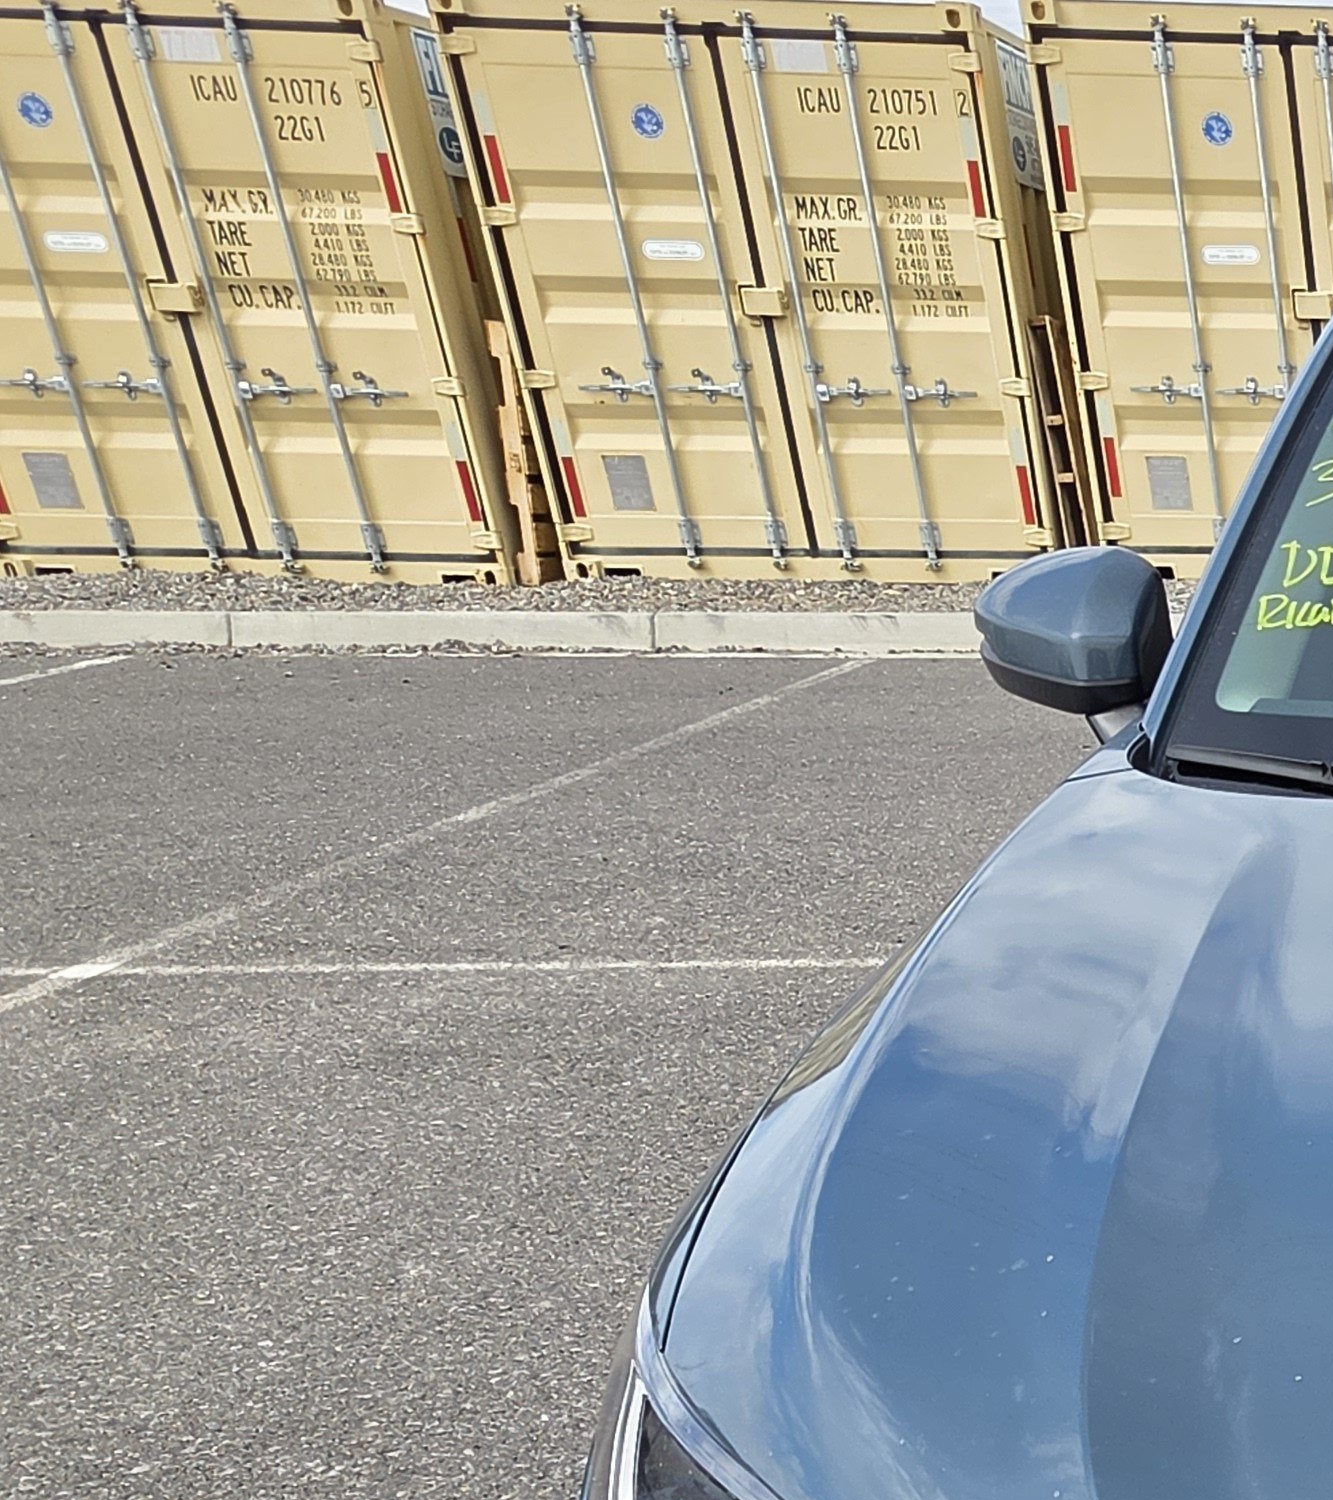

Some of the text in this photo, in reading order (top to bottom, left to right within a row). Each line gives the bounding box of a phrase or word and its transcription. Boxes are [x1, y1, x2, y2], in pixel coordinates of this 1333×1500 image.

[190, 74, 238, 101] ICAU
[264, 77, 342, 106] 210776
[797, 86, 841, 113] ICAU
[867, 88, 937, 115] 210751
[274, 114, 326, 142] 22G1
[873, 125, 921, 151] 22G1
[344, 207, 363, 219] LBS
[927, 197, 946, 210] KGS
[929, 214, 947, 226] LBS
[206, 220, 252, 247] TARE
[349, 238, 370, 252] LBS
[798, 227, 841, 253] TARE
[930, 229, 949, 242] KGS
[933, 244, 952, 257] LBS
[215, 251, 252, 277] NET
[804, 257, 836, 282] NET
